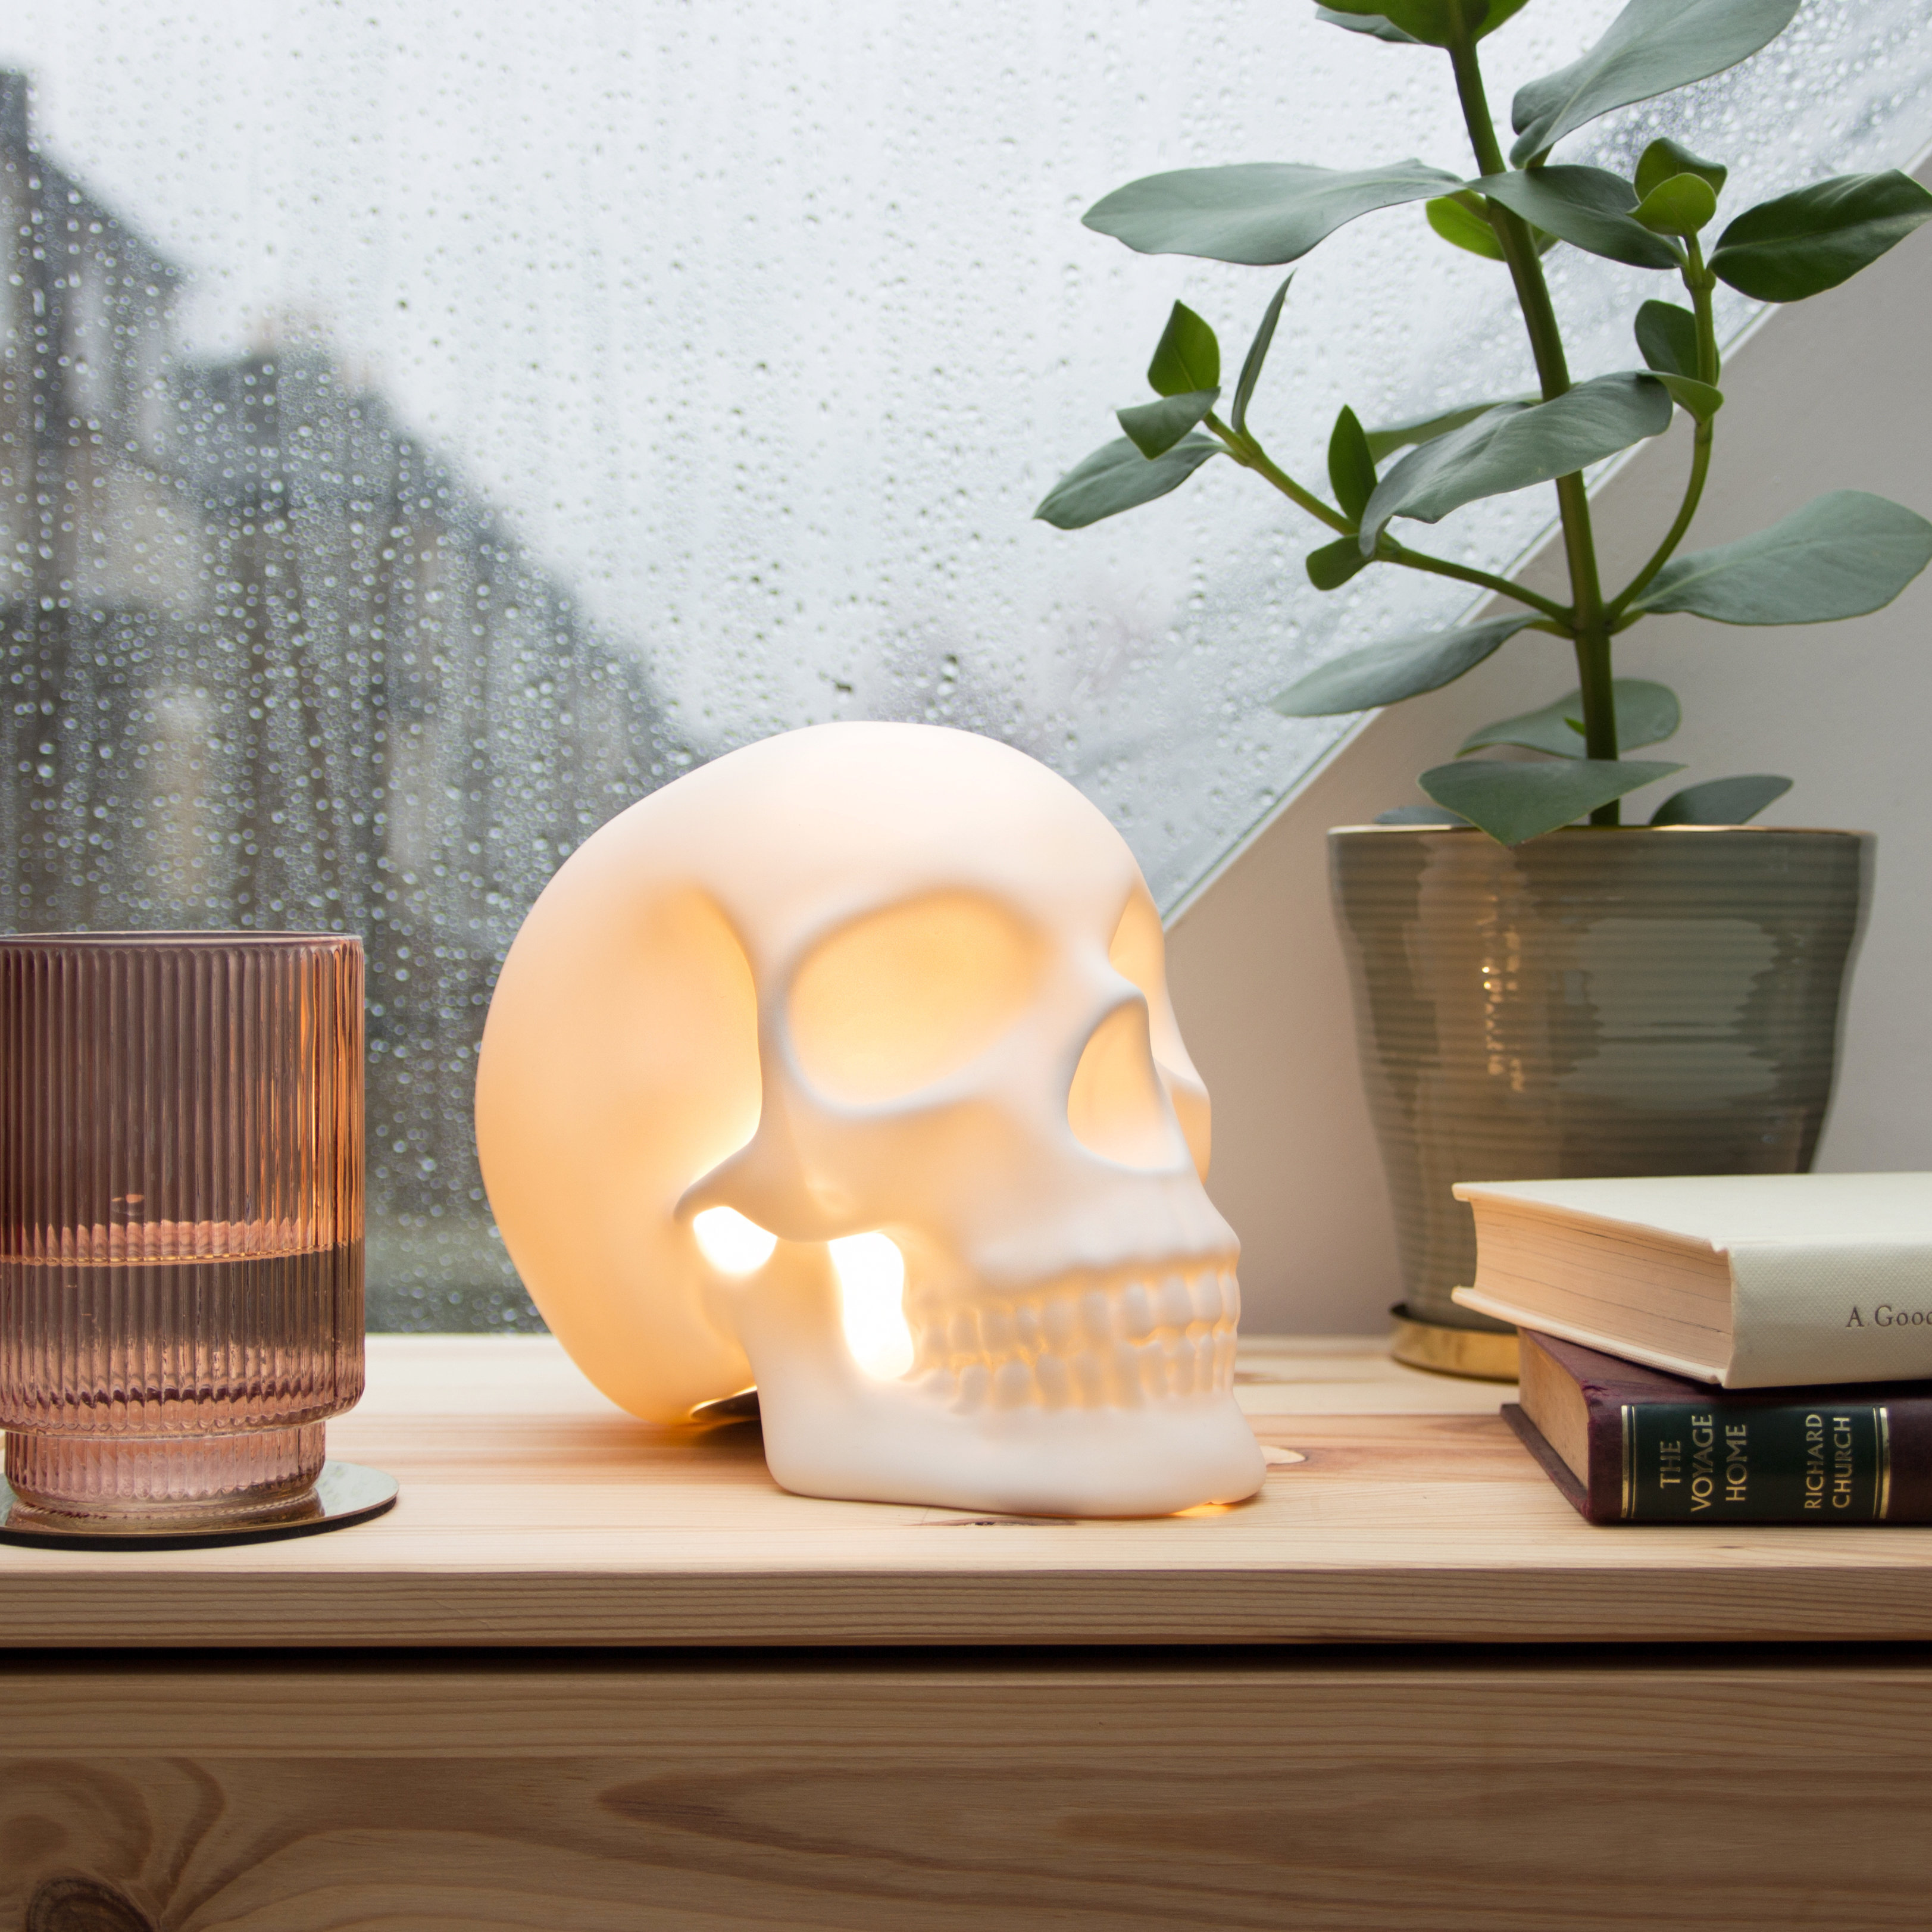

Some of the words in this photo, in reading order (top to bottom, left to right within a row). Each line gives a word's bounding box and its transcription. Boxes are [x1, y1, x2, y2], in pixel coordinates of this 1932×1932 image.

[1846, 1306, 1865, 1327] A
[1659, 1440, 1681, 1489] THE
[1690, 1414, 1714, 1512] VOYAGE
[1725, 1424, 1747, 1501] HOME
[1804, 1414, 1824, 1509] RICHARD
[1832, 1417, 1853, 1508] CHURCH
